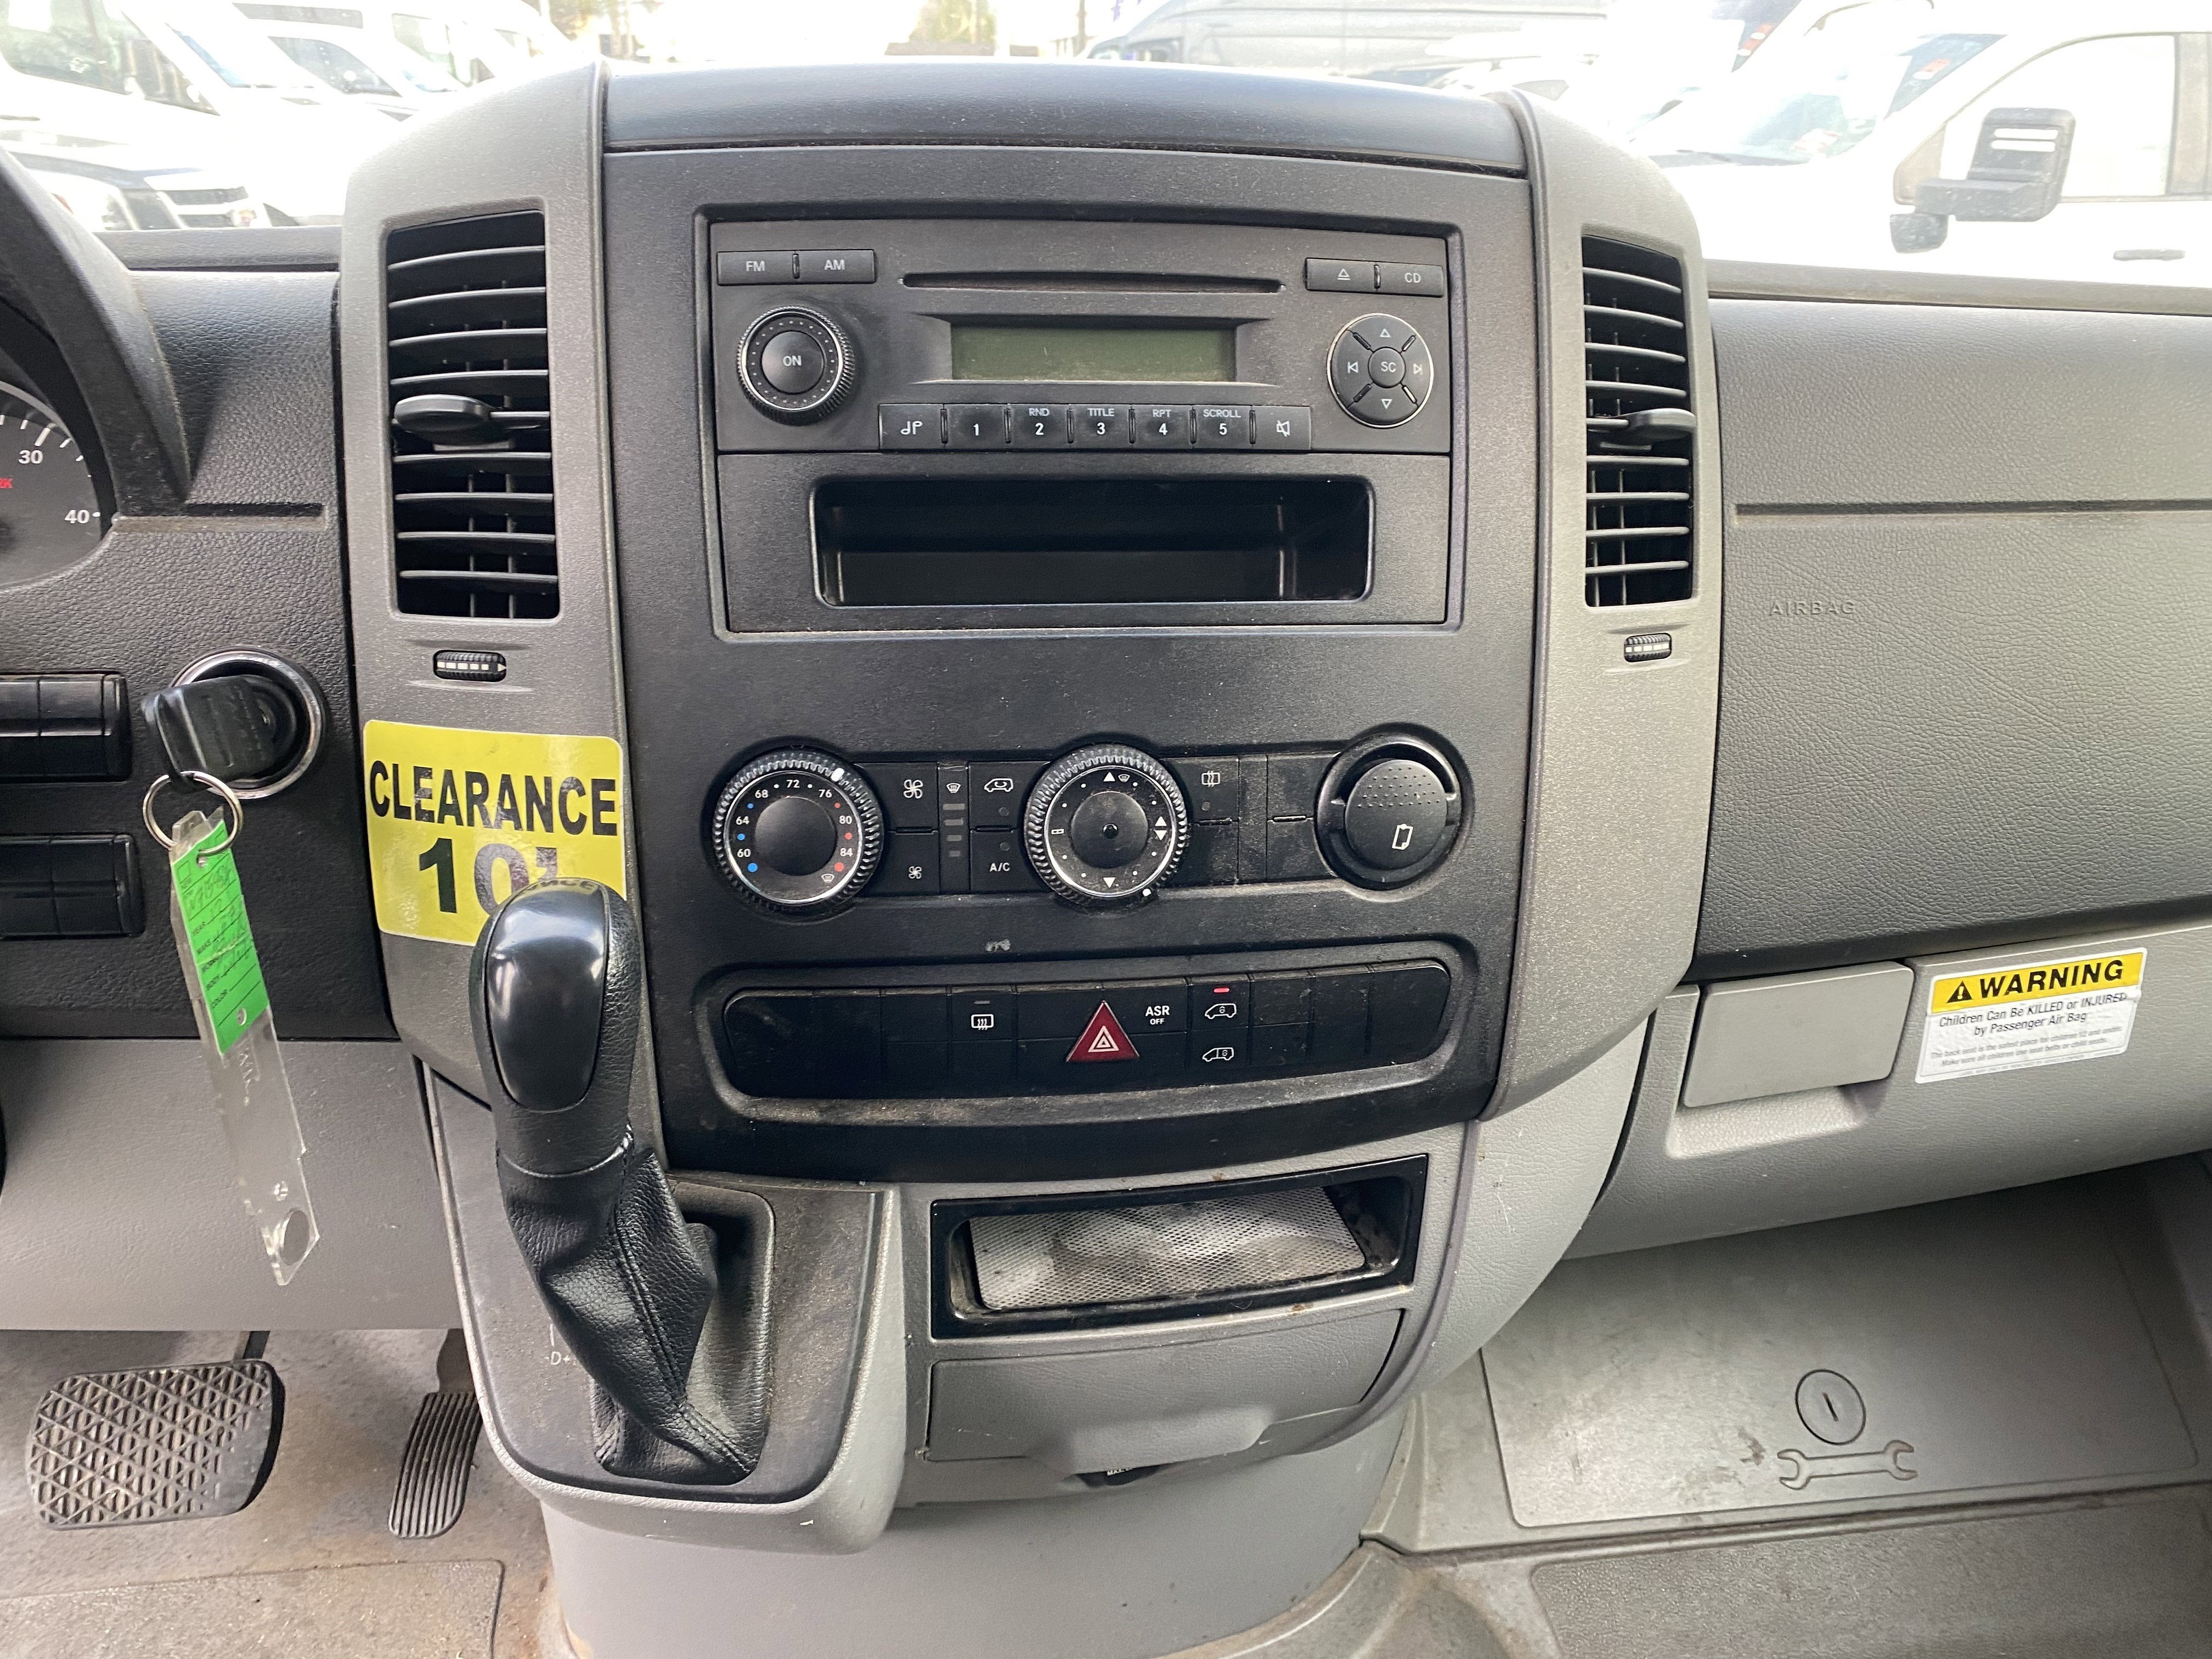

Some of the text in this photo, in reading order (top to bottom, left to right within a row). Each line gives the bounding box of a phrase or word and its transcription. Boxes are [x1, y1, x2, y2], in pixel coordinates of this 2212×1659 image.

[746, 260, 765, 272] FM
[824, 259, 845, 270] AM
[1404, 272, 1421, 283] CD
[780, 355, 802, 367] ON
[1381, 361, 1396, 373] SC
[1029, 408, 1050, 416] RND
[1087, 408, 1115, 417] TITLE
[1152, 409, 1172, 417] RPT
[1203, 409, 1242, 418] SCROLL
[973, 424, 979, 436] 1
[1035, 422, 1044, 436] 2
[1097, 422, 1105, 435] 3
[1159, 423, 1168, 436] 4
[1219, 423, 1227, 435] 5
[18, 450, 43, 464] 30
[64, 509, 89, 524] 40
[1769, 600, 1855, 616] AIRBAG
[786, 779, 800, 788] 72
[369, 760, 617, 837] CLEARANCE
[755, 789, 769, 799] 68
[819, 789, 832, 798] 76
[736, 816, 750, 825] 64
[839, 815, 853, 825] 80
[737, 848, 751, 857] 60
[840, 848, 854, 857] 84
[989, 862, 1011, 872] A/C
[1979, 960, 2123, 999] WARNING
[1145, 1005, 1170, 1017] ASR
[1940, 992, 2127, 1026] Children Can Be KILLED or INJURED
[1974, 1013, 2087, 1036] by Passenger Air Bag
